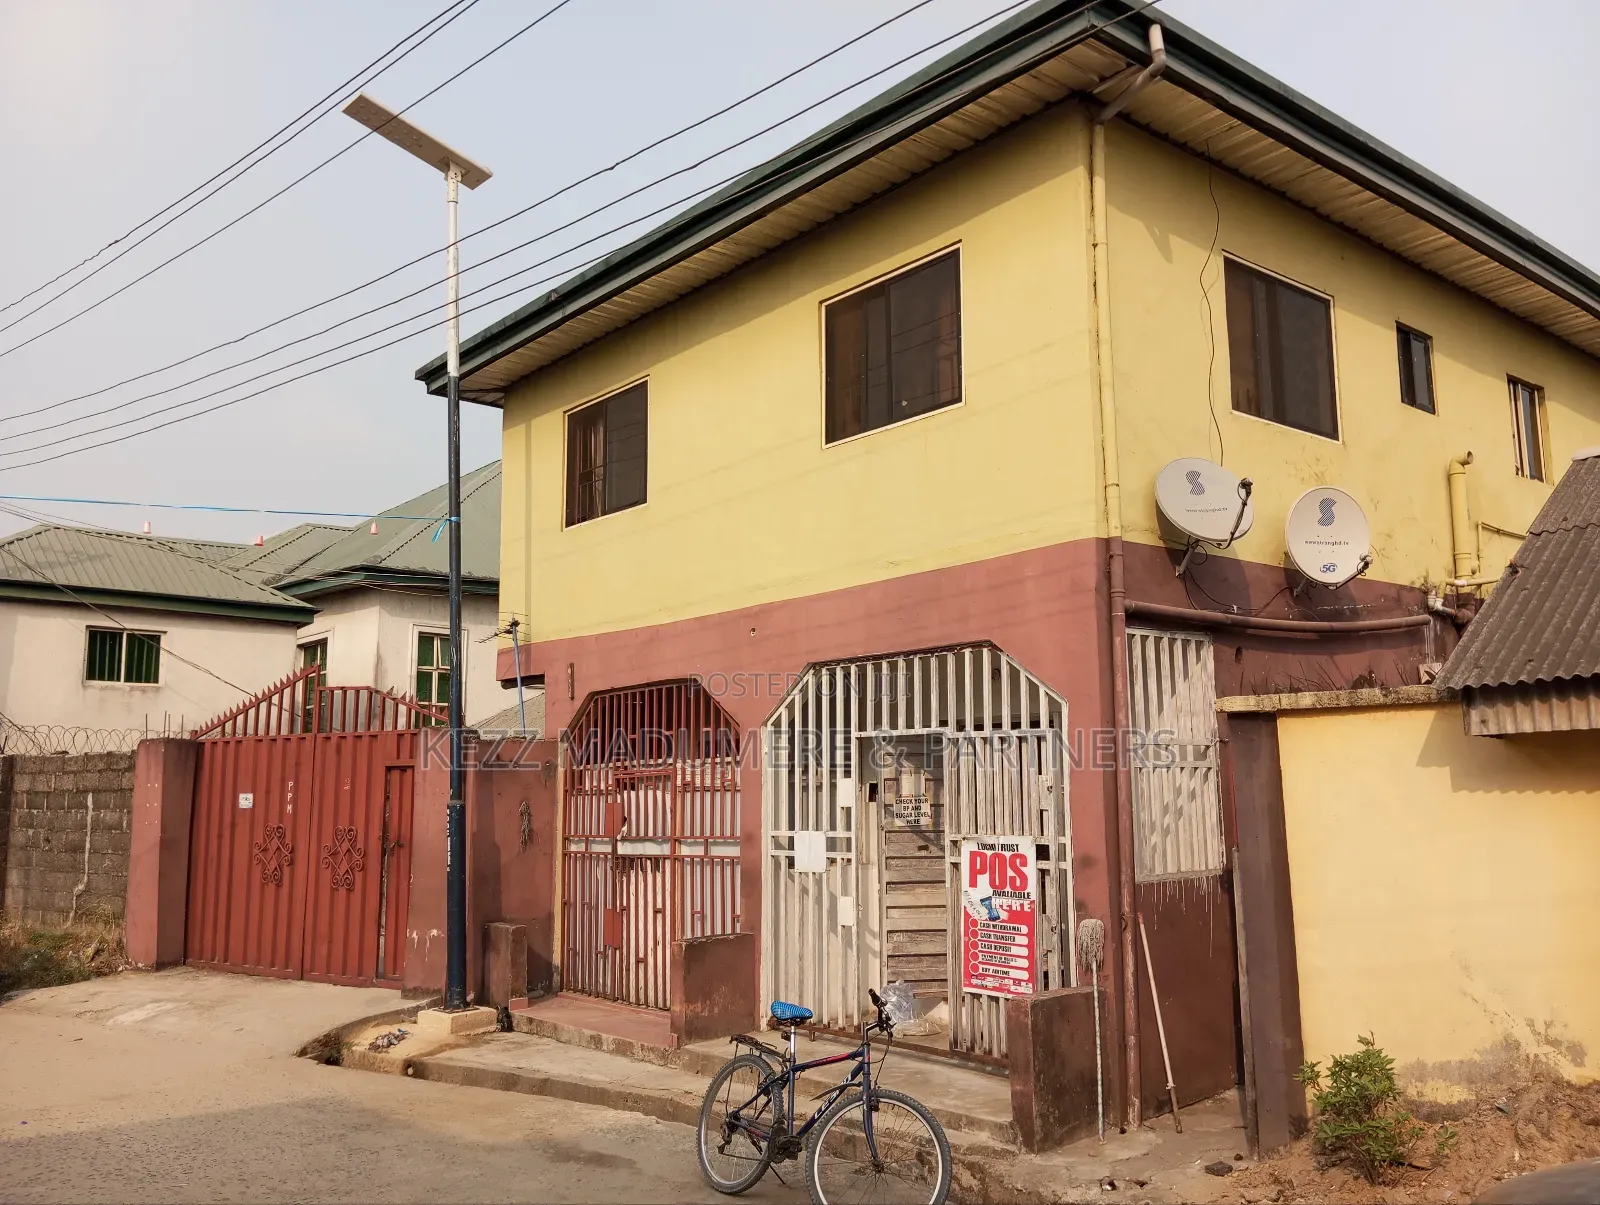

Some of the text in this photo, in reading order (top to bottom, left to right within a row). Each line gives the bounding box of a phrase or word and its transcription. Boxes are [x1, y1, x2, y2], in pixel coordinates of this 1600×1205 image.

[1321, 564, 1337, 573] 5G
[969, 851, 1028, 892] POS
[991, 898, 1031, 912] HERE
[980, 932, 1016, 942] CASH TRANSFER
[993, 944, 1012, 953] DEPOSIT
